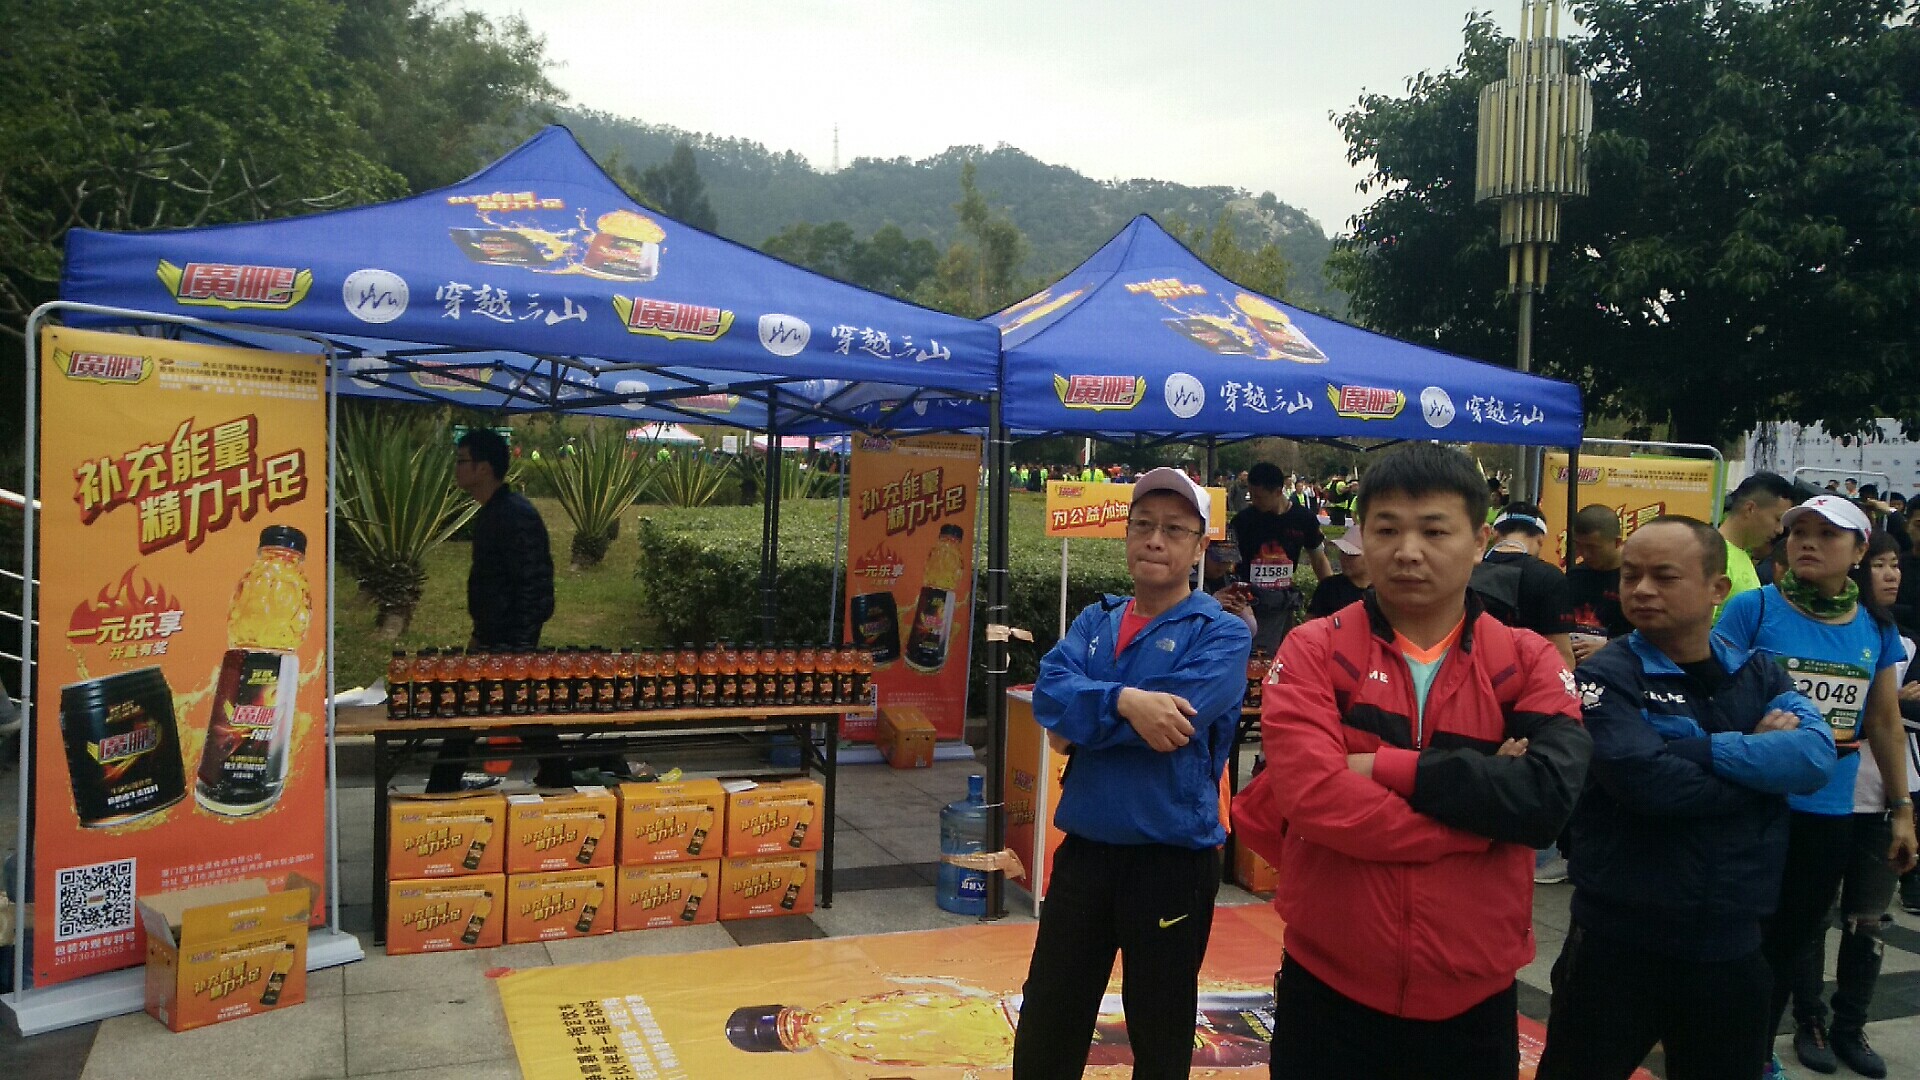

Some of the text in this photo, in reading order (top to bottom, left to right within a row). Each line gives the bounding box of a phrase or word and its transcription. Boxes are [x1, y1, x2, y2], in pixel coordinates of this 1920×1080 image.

[178, 262, 297, 303] 廣鵬
[435, 281, 588, 325] 穿越三山
[629, 298, 721, 335] 廣鵬
[831, 324, 951, 362] 穿越三山
[1064, 375, 1135, 405] 廣鵬
[1220, 381, 1313, 414] 穿越三山
[1339, 385, 1397, 413] 廣鵬
[1466, 395, 1544, 425] 穿越三山
[76, 417, 252, 511] 补充能量
[140, 451, 301, 544] 精力十足
[862, 469, 940, 514] 补充能量
[888, 486, 964, 531] 精力十足
[1053, 501, 1130, 527] 为公益加油
[1255, 567, 1289, 577] 21588
[66, 610, 185, 645] 一元乐享
[1800, 679, 1858, 705] 2048
